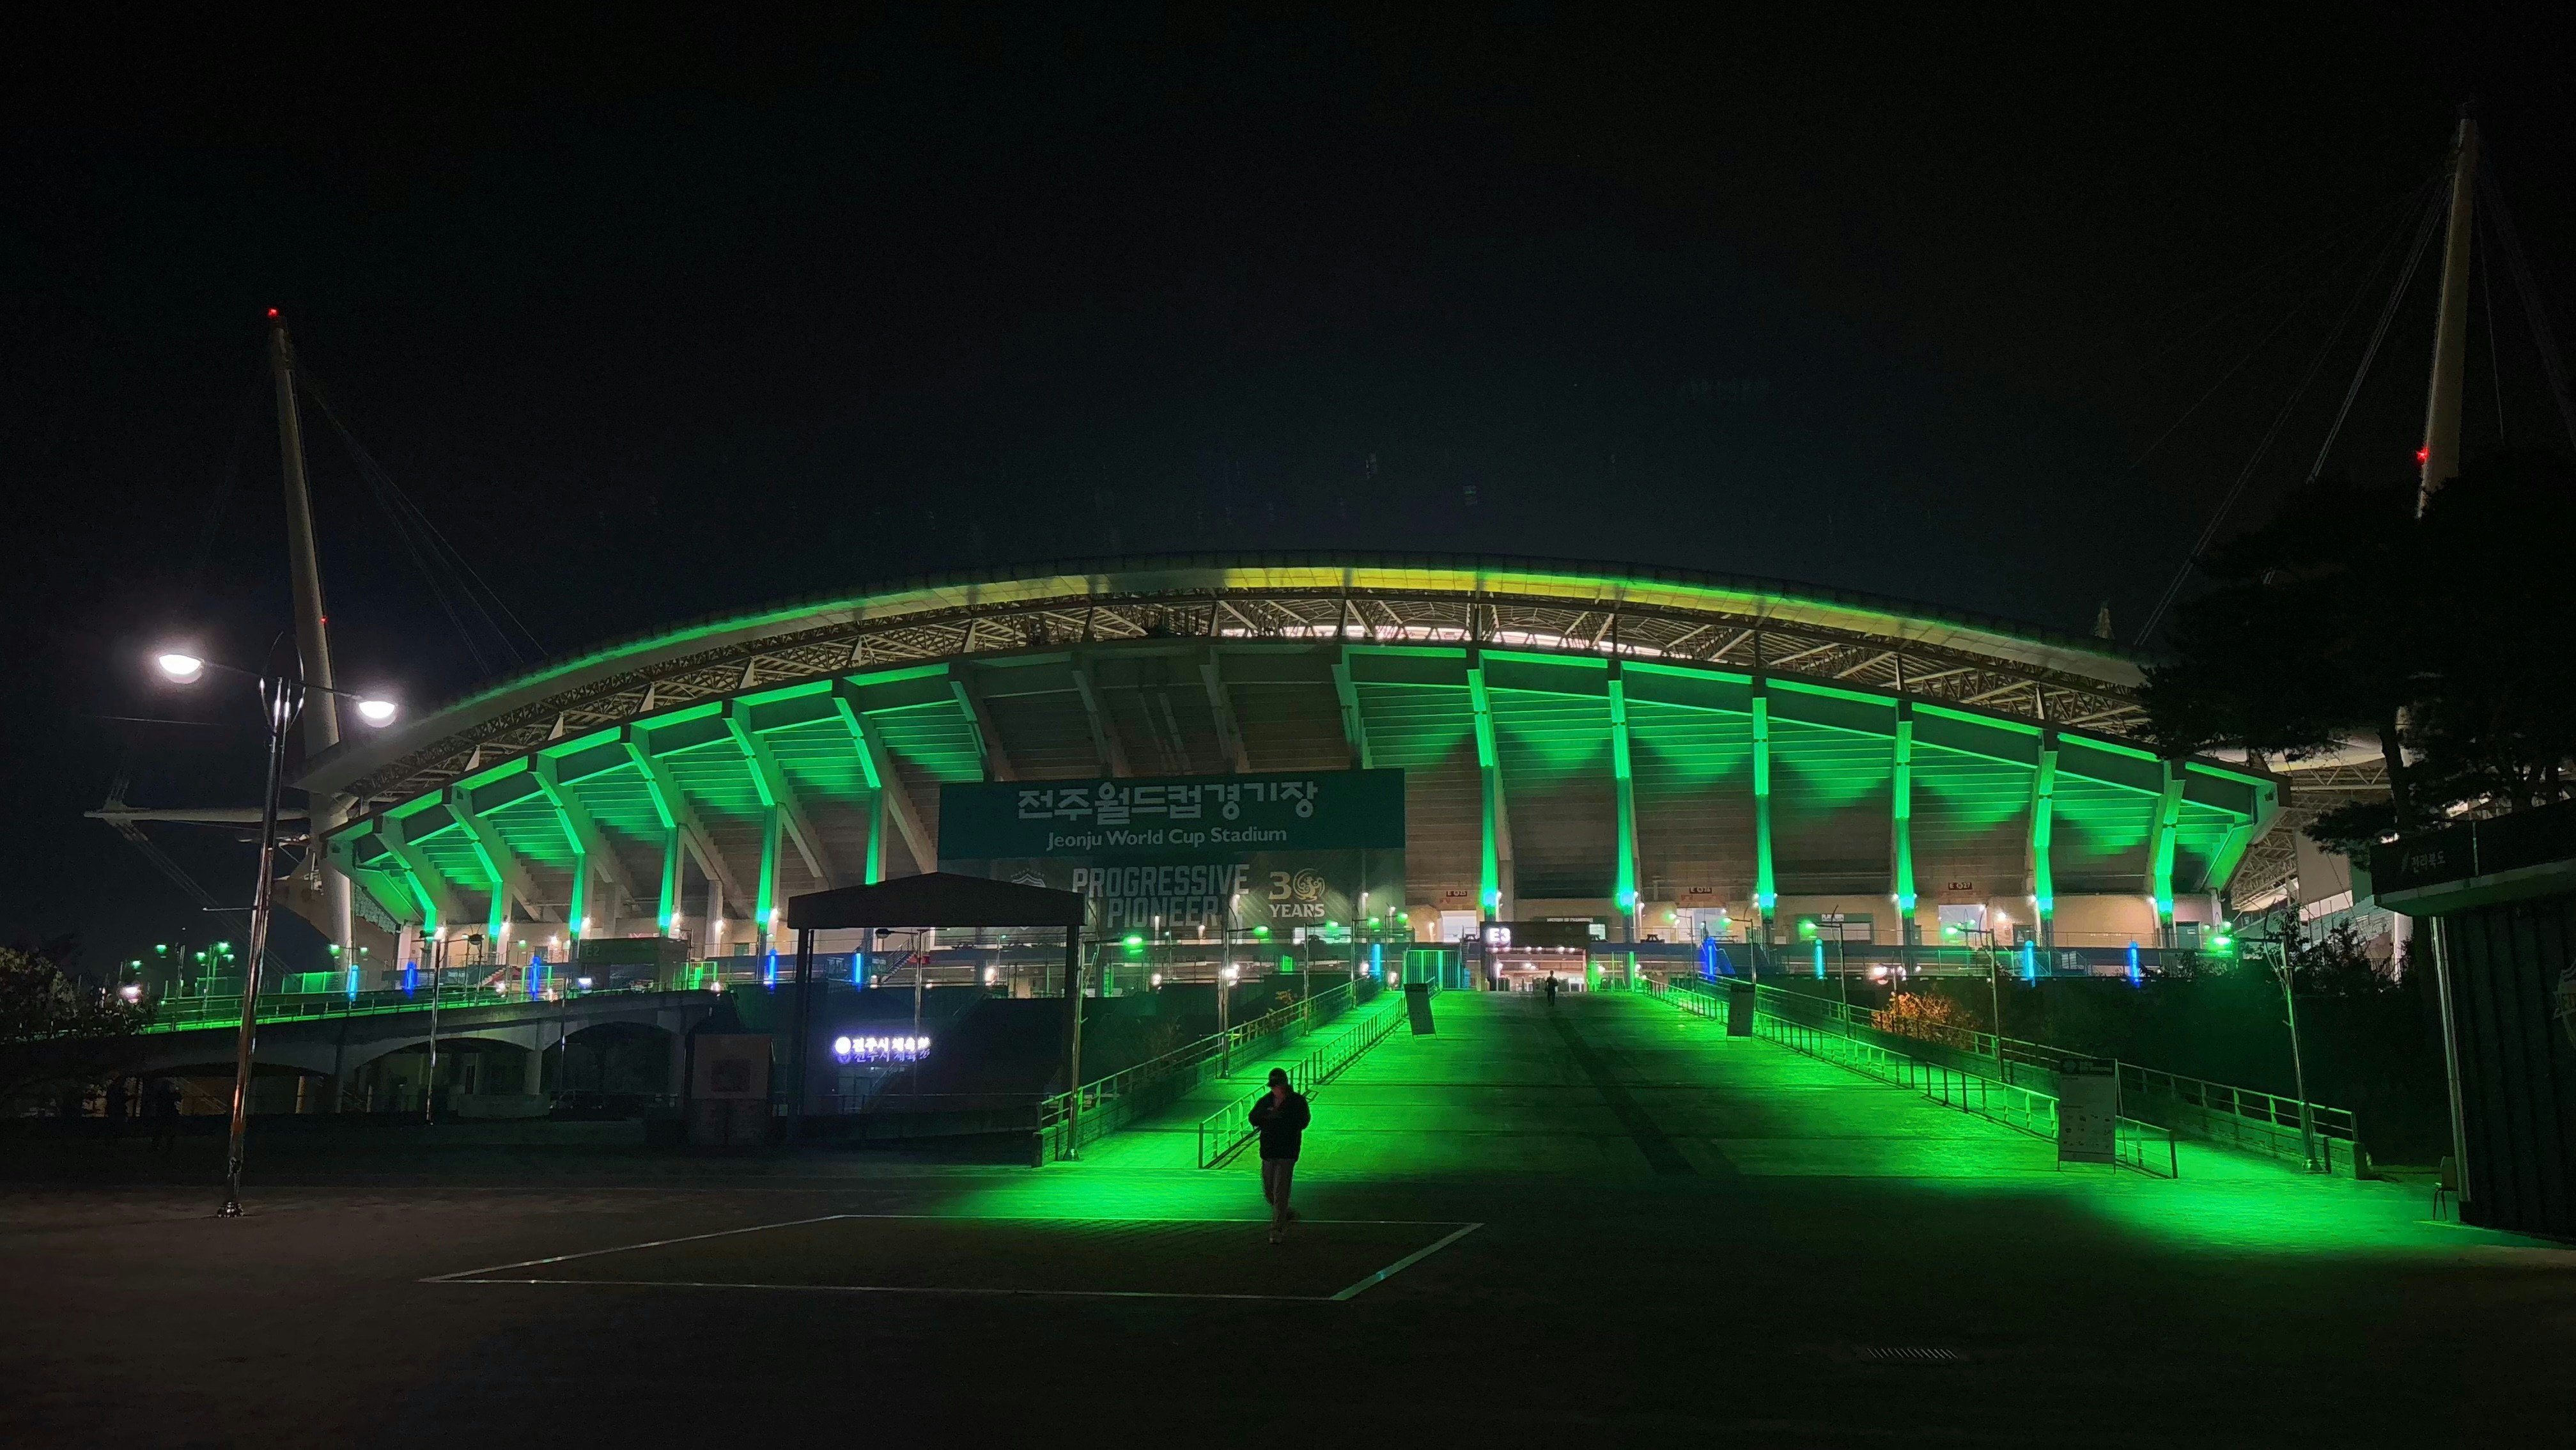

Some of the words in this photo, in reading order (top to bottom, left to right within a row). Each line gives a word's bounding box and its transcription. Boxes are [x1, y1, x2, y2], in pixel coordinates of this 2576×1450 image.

[1017, 781, 1319, 825] 전주월드컵경기장
[1046, 831, 1102, 852] Jeonju
[1105, 829, 1163, 846] World
[1168, 828, 1206, 849] Cup
[1210, 825, 1287, 844] Stadium
[2411, 850, 2446, 873] 전라북도
[1072, 863, 1250, 898] PROGRESSIVE
[1106, 896, 1223, 928] PIONEER
[1268, 903, 1326, 919] YEARS
[1489, 927, 1510, 942] E3
